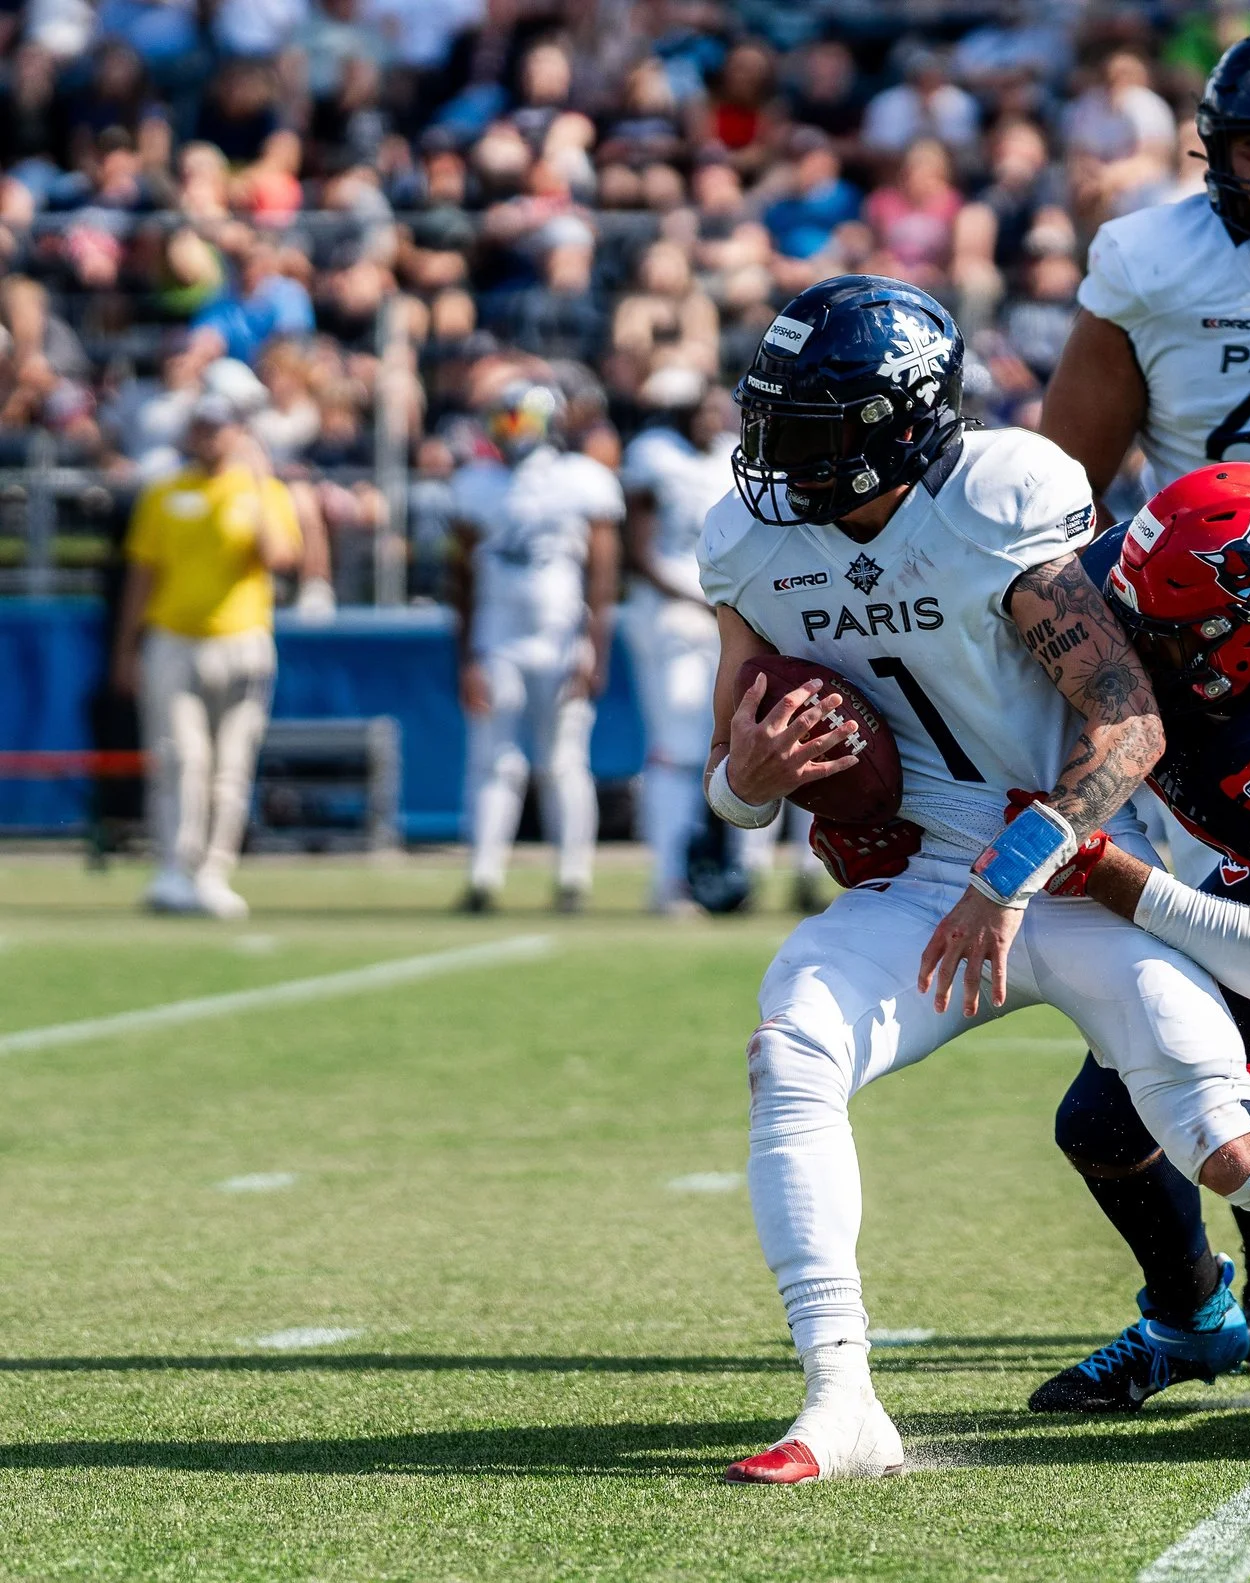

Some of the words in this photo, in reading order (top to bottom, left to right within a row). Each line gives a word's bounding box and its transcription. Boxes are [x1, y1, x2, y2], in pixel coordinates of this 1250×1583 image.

[747, 375, 783, 395] FORELLE
[801, 597, 944, 641] PARIS
[1022, 618, 1056, 652] LOVE
[868, 656, 987, 784] 1
